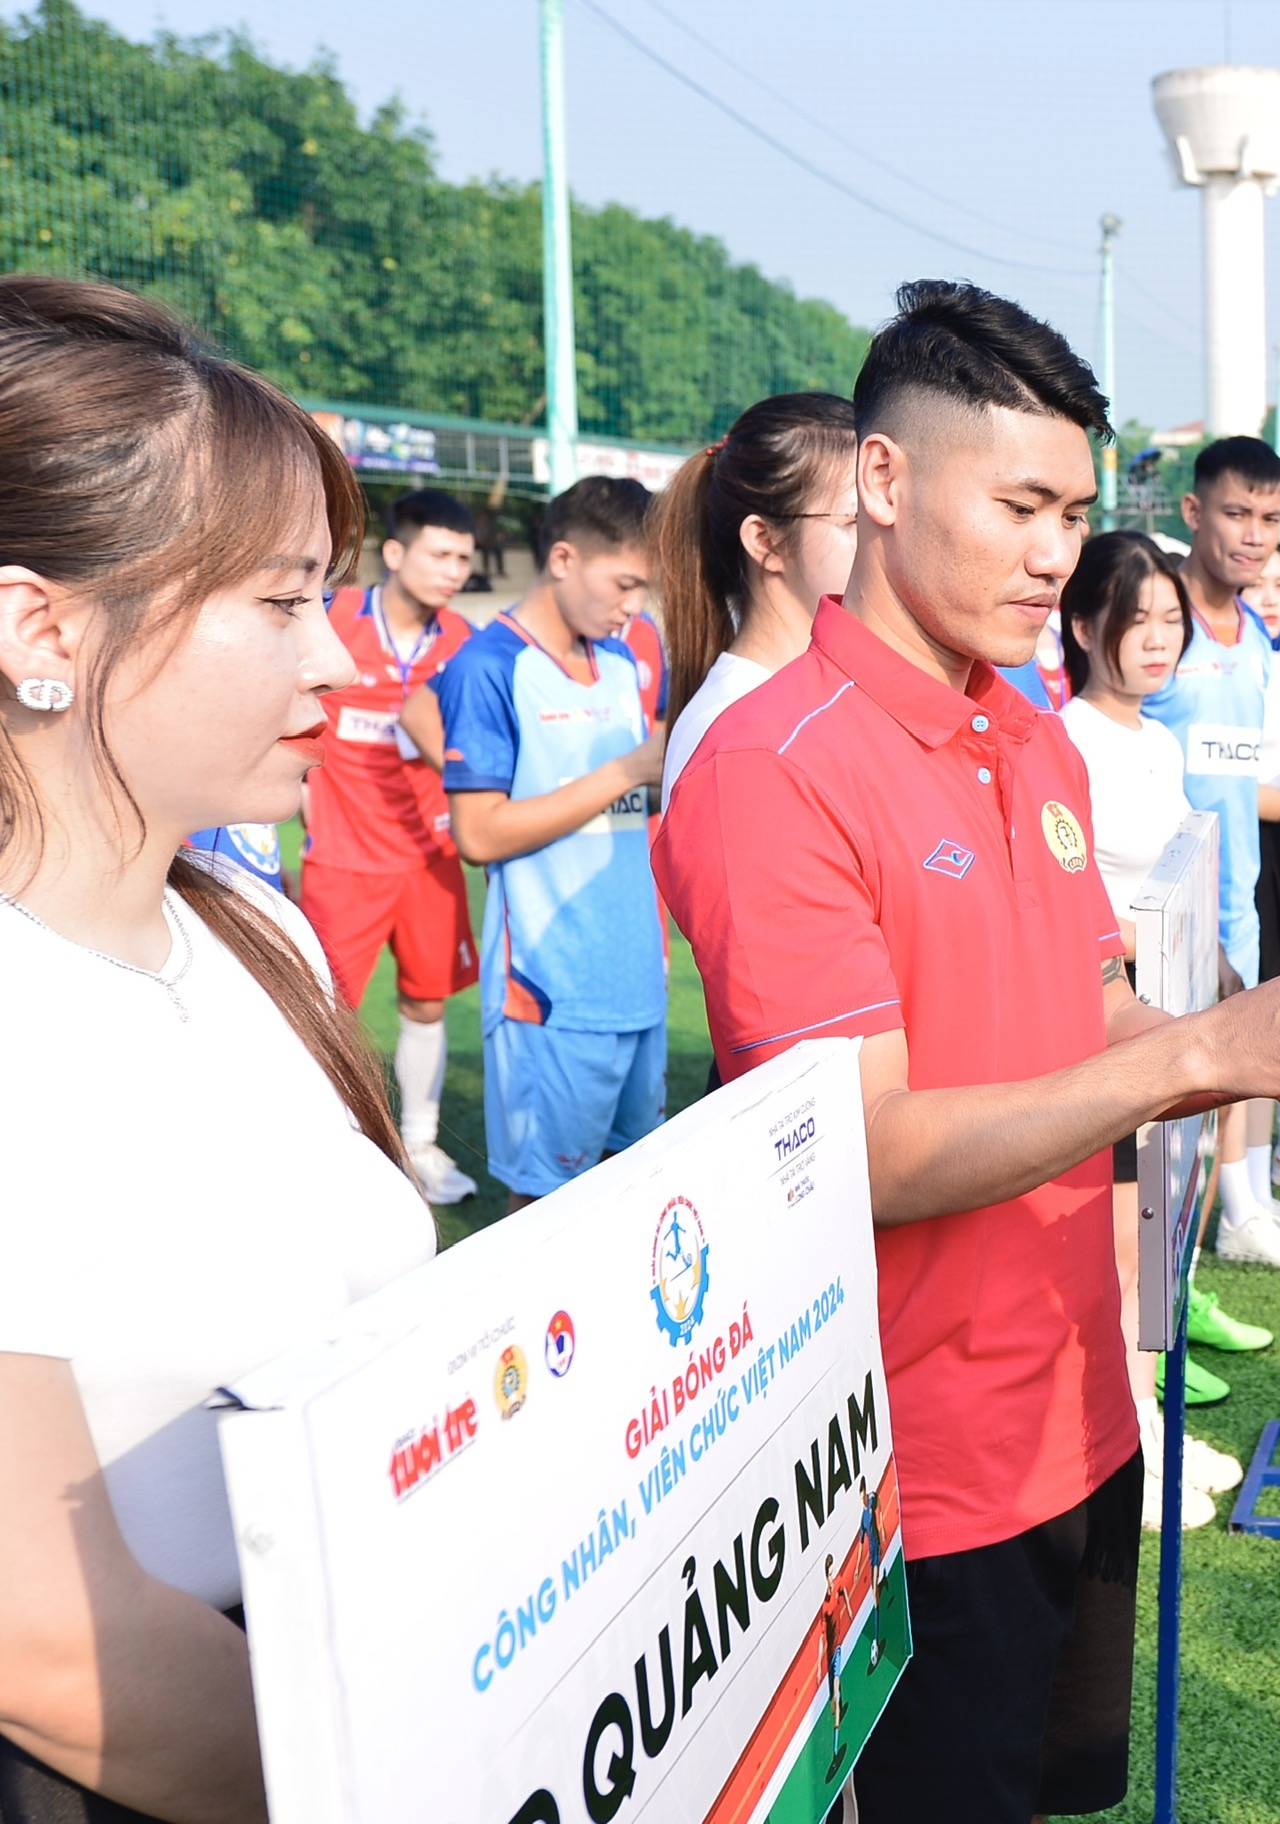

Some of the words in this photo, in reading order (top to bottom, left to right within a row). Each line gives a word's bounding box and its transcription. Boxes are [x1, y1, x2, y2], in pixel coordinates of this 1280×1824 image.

[774, 1116, 816, 1162] THACO
[472, 1577, 557, 1692] CÔNG
[561, 1499, 636, 1601] NHÂN,
[638, 1439, 686, 1516] VIÊN
[689, 1385, 740, 1462] CHỨC
[740, 1344, 775, 1405] VIỆT
[778, 1308, 812, 1370] NAM
[813, 1275, 845, 1334] 2024
[625, 1385, 669, 1459] GIẢI
[672, 1351, 726, 1417] BÓNG
[729, 1299, 754, 1360] ĐÁ
[583, 1497, 786, 1823] QUẢNG
[795, 1370, 878, 1554] NAM
